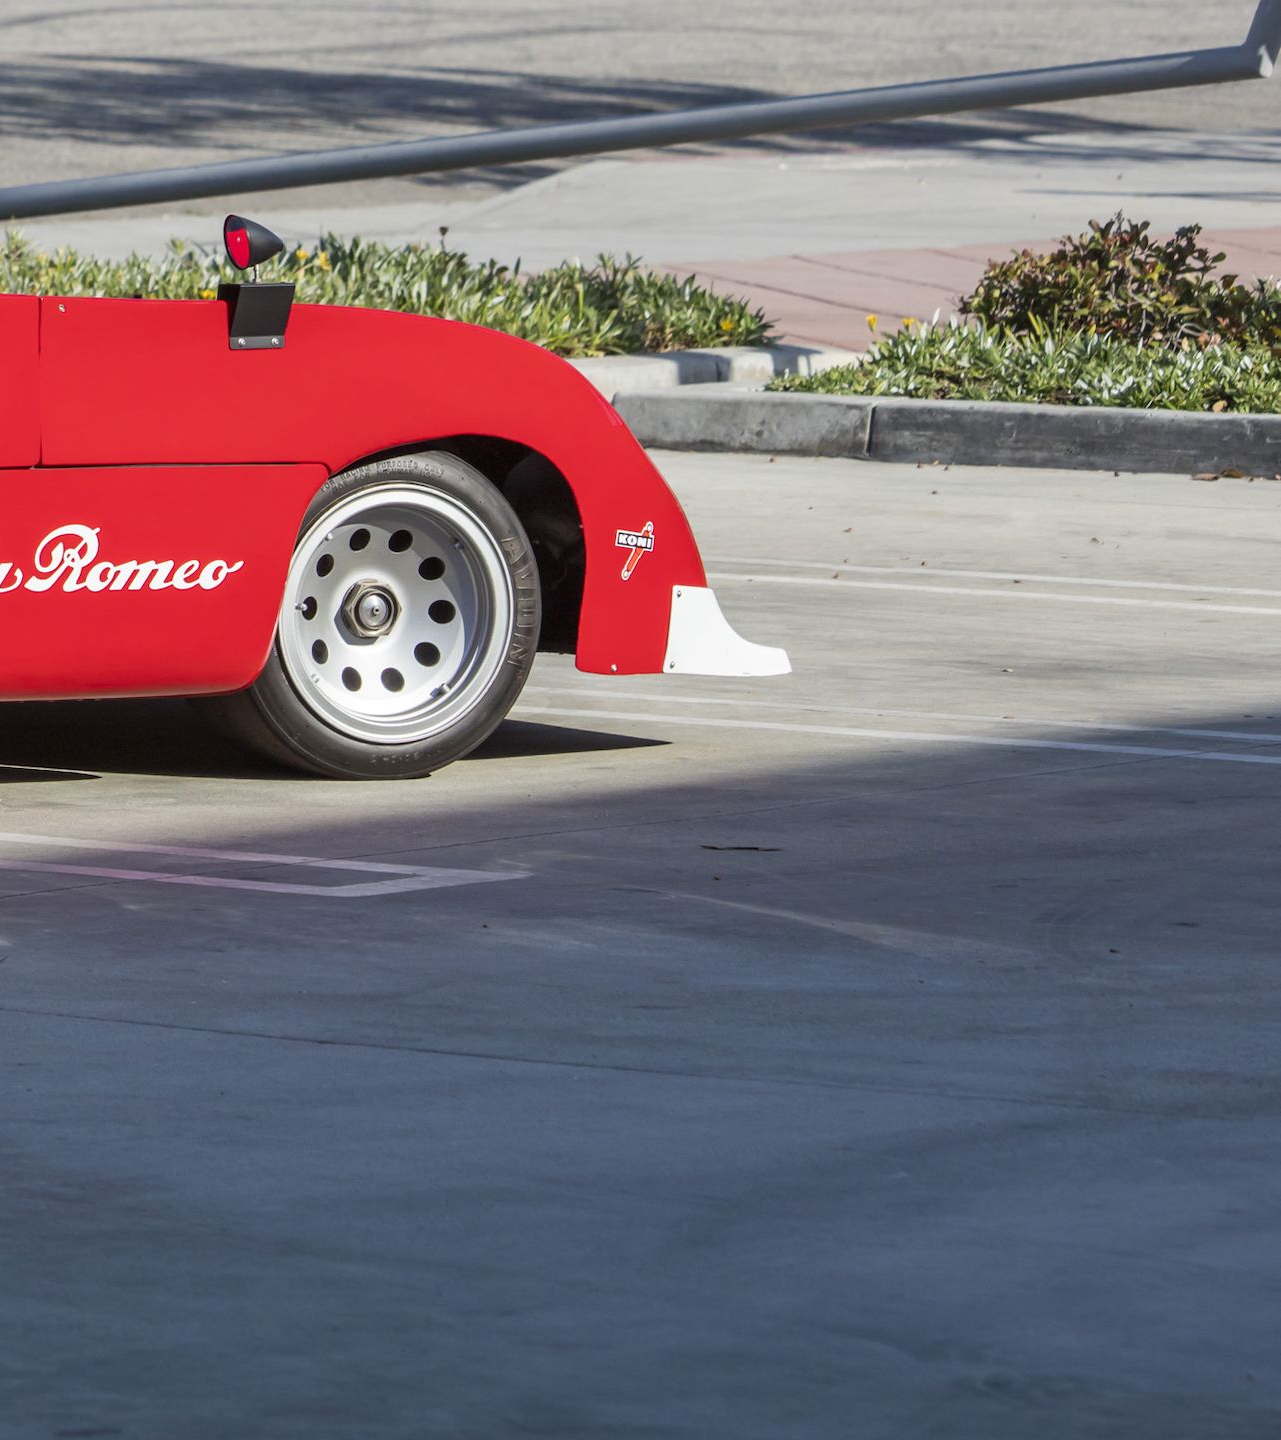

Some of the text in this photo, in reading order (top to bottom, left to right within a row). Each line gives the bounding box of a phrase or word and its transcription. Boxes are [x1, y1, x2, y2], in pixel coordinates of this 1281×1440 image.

[23, 524, 244, 594] Romeo
[619, 533, 652, 549] KONI
[499, 538, 538, 667] AVON
